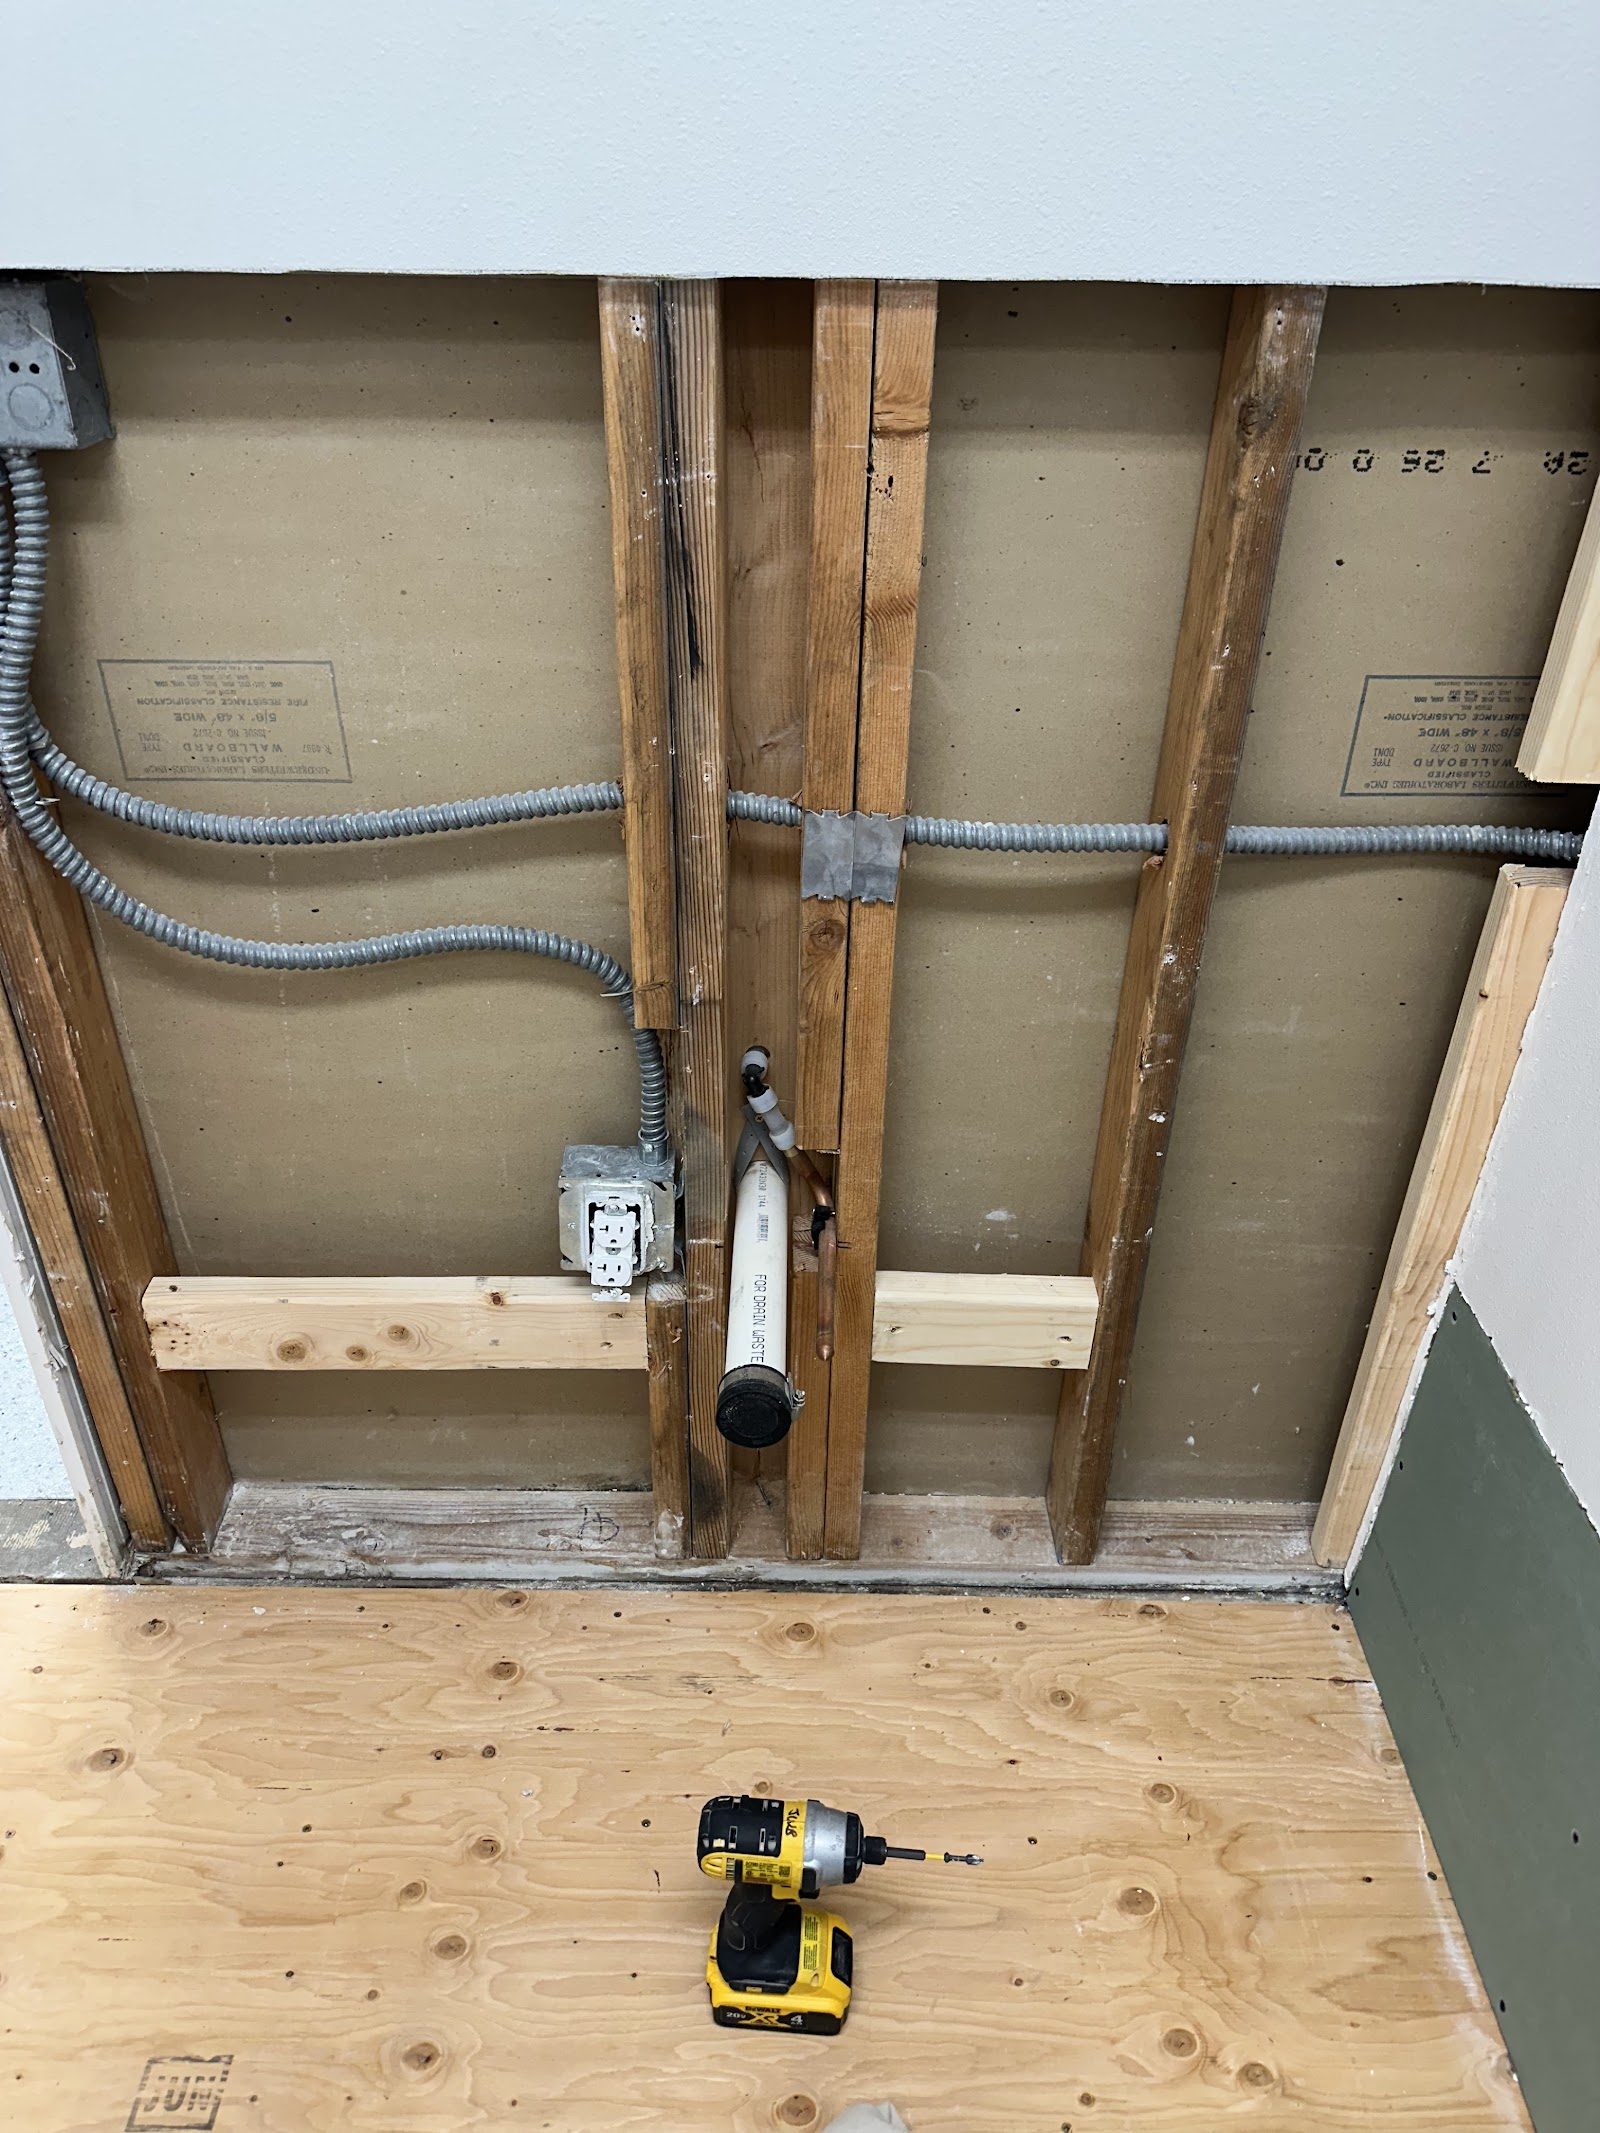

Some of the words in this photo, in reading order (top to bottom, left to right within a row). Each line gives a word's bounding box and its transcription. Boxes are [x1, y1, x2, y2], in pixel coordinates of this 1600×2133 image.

[221, 698, 281, 706] RESISTANCE
[173, 713, 206, 721] WIDE
[1418, 728, 1450, 737] WIDE
[183, 743, 283, 753] WALLBOARD
[1481, 744, 1503, 752] ISSUE
[1371, 758, 1391, 767] TYPE
[1413, 759, 1512, 767] WALLBOARD
[1392, 781, 1466, 789] LABORATORIES
[754, 1275, 766, 1292] FOR
[753, 1296, 765, 1325] DRAIN
[751, 1330, 765, 1363] WASTE
